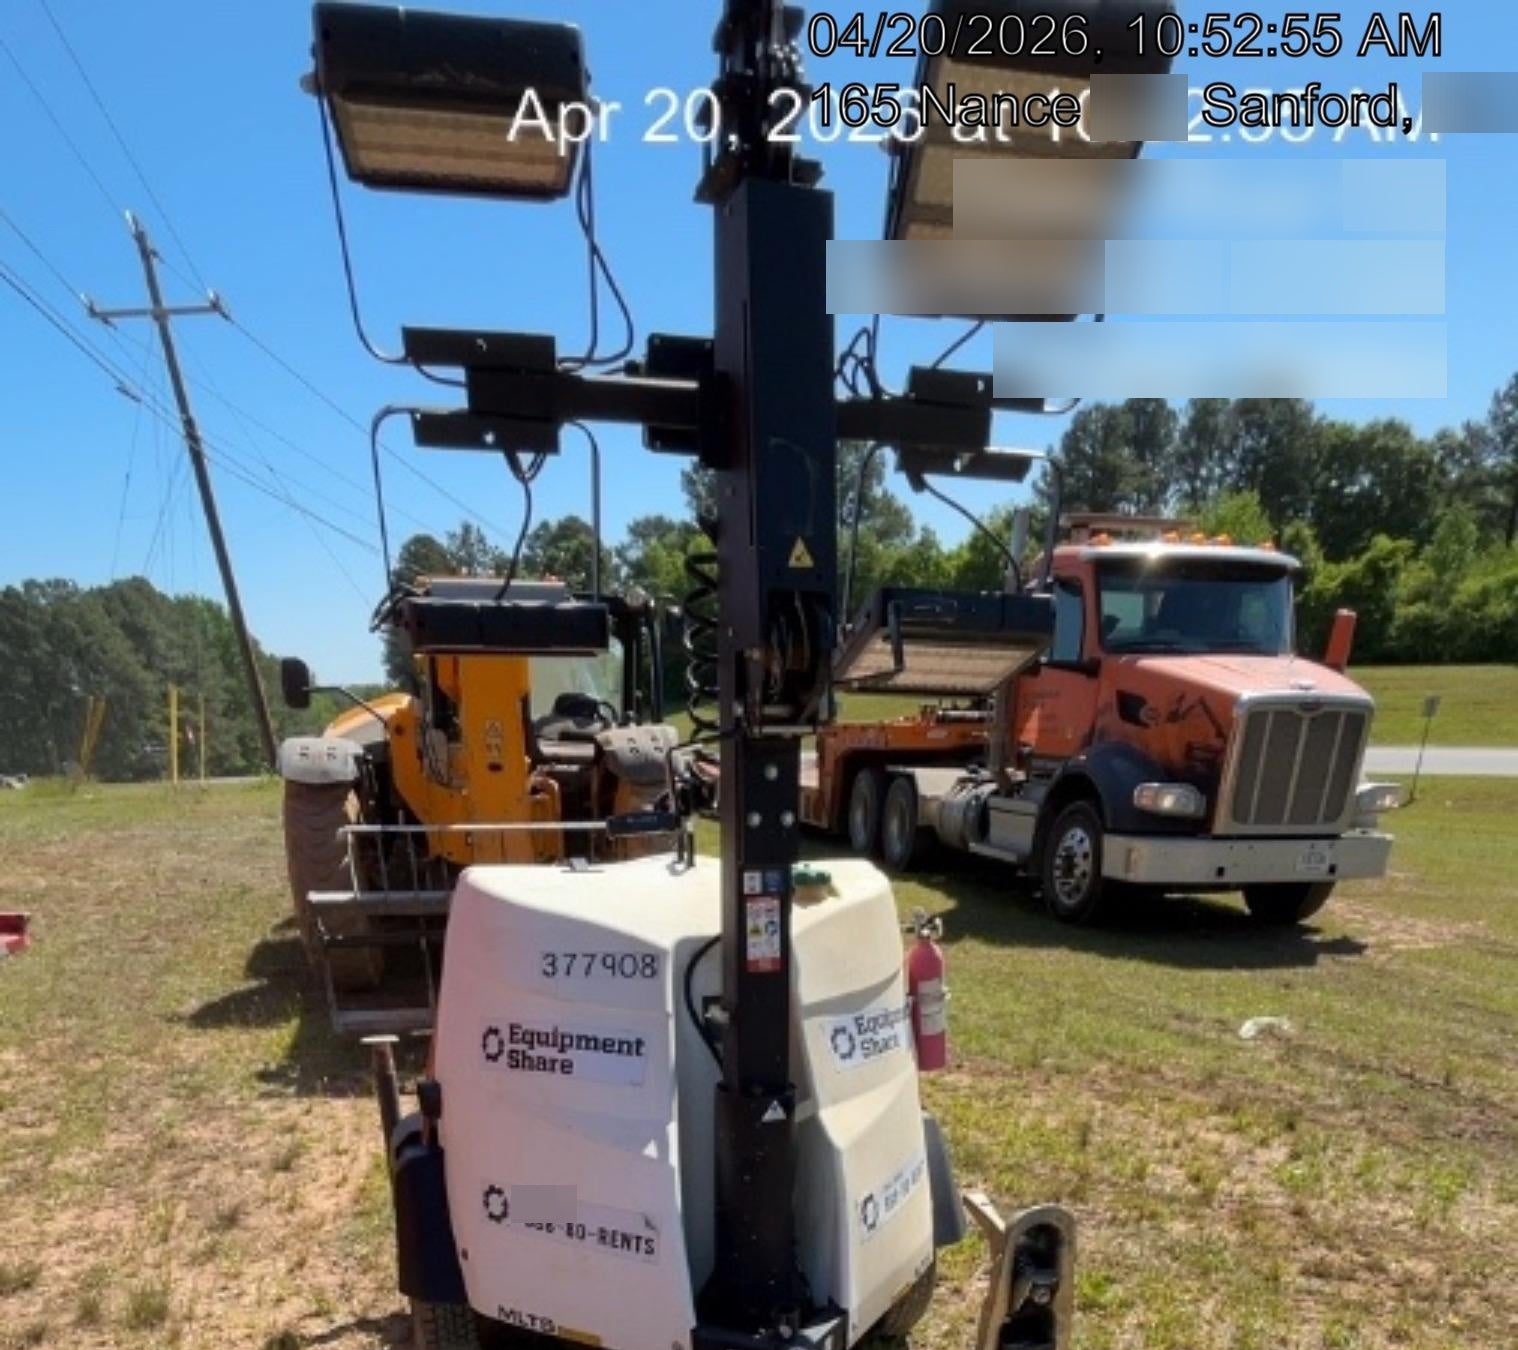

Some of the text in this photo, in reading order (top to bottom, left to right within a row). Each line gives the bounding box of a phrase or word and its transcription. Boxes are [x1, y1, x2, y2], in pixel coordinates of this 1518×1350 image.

[542, 953, 657, 979] 377908
[508, 1023, 646, 1058] Equipment
[507, 1049, 575, 1075] Share
